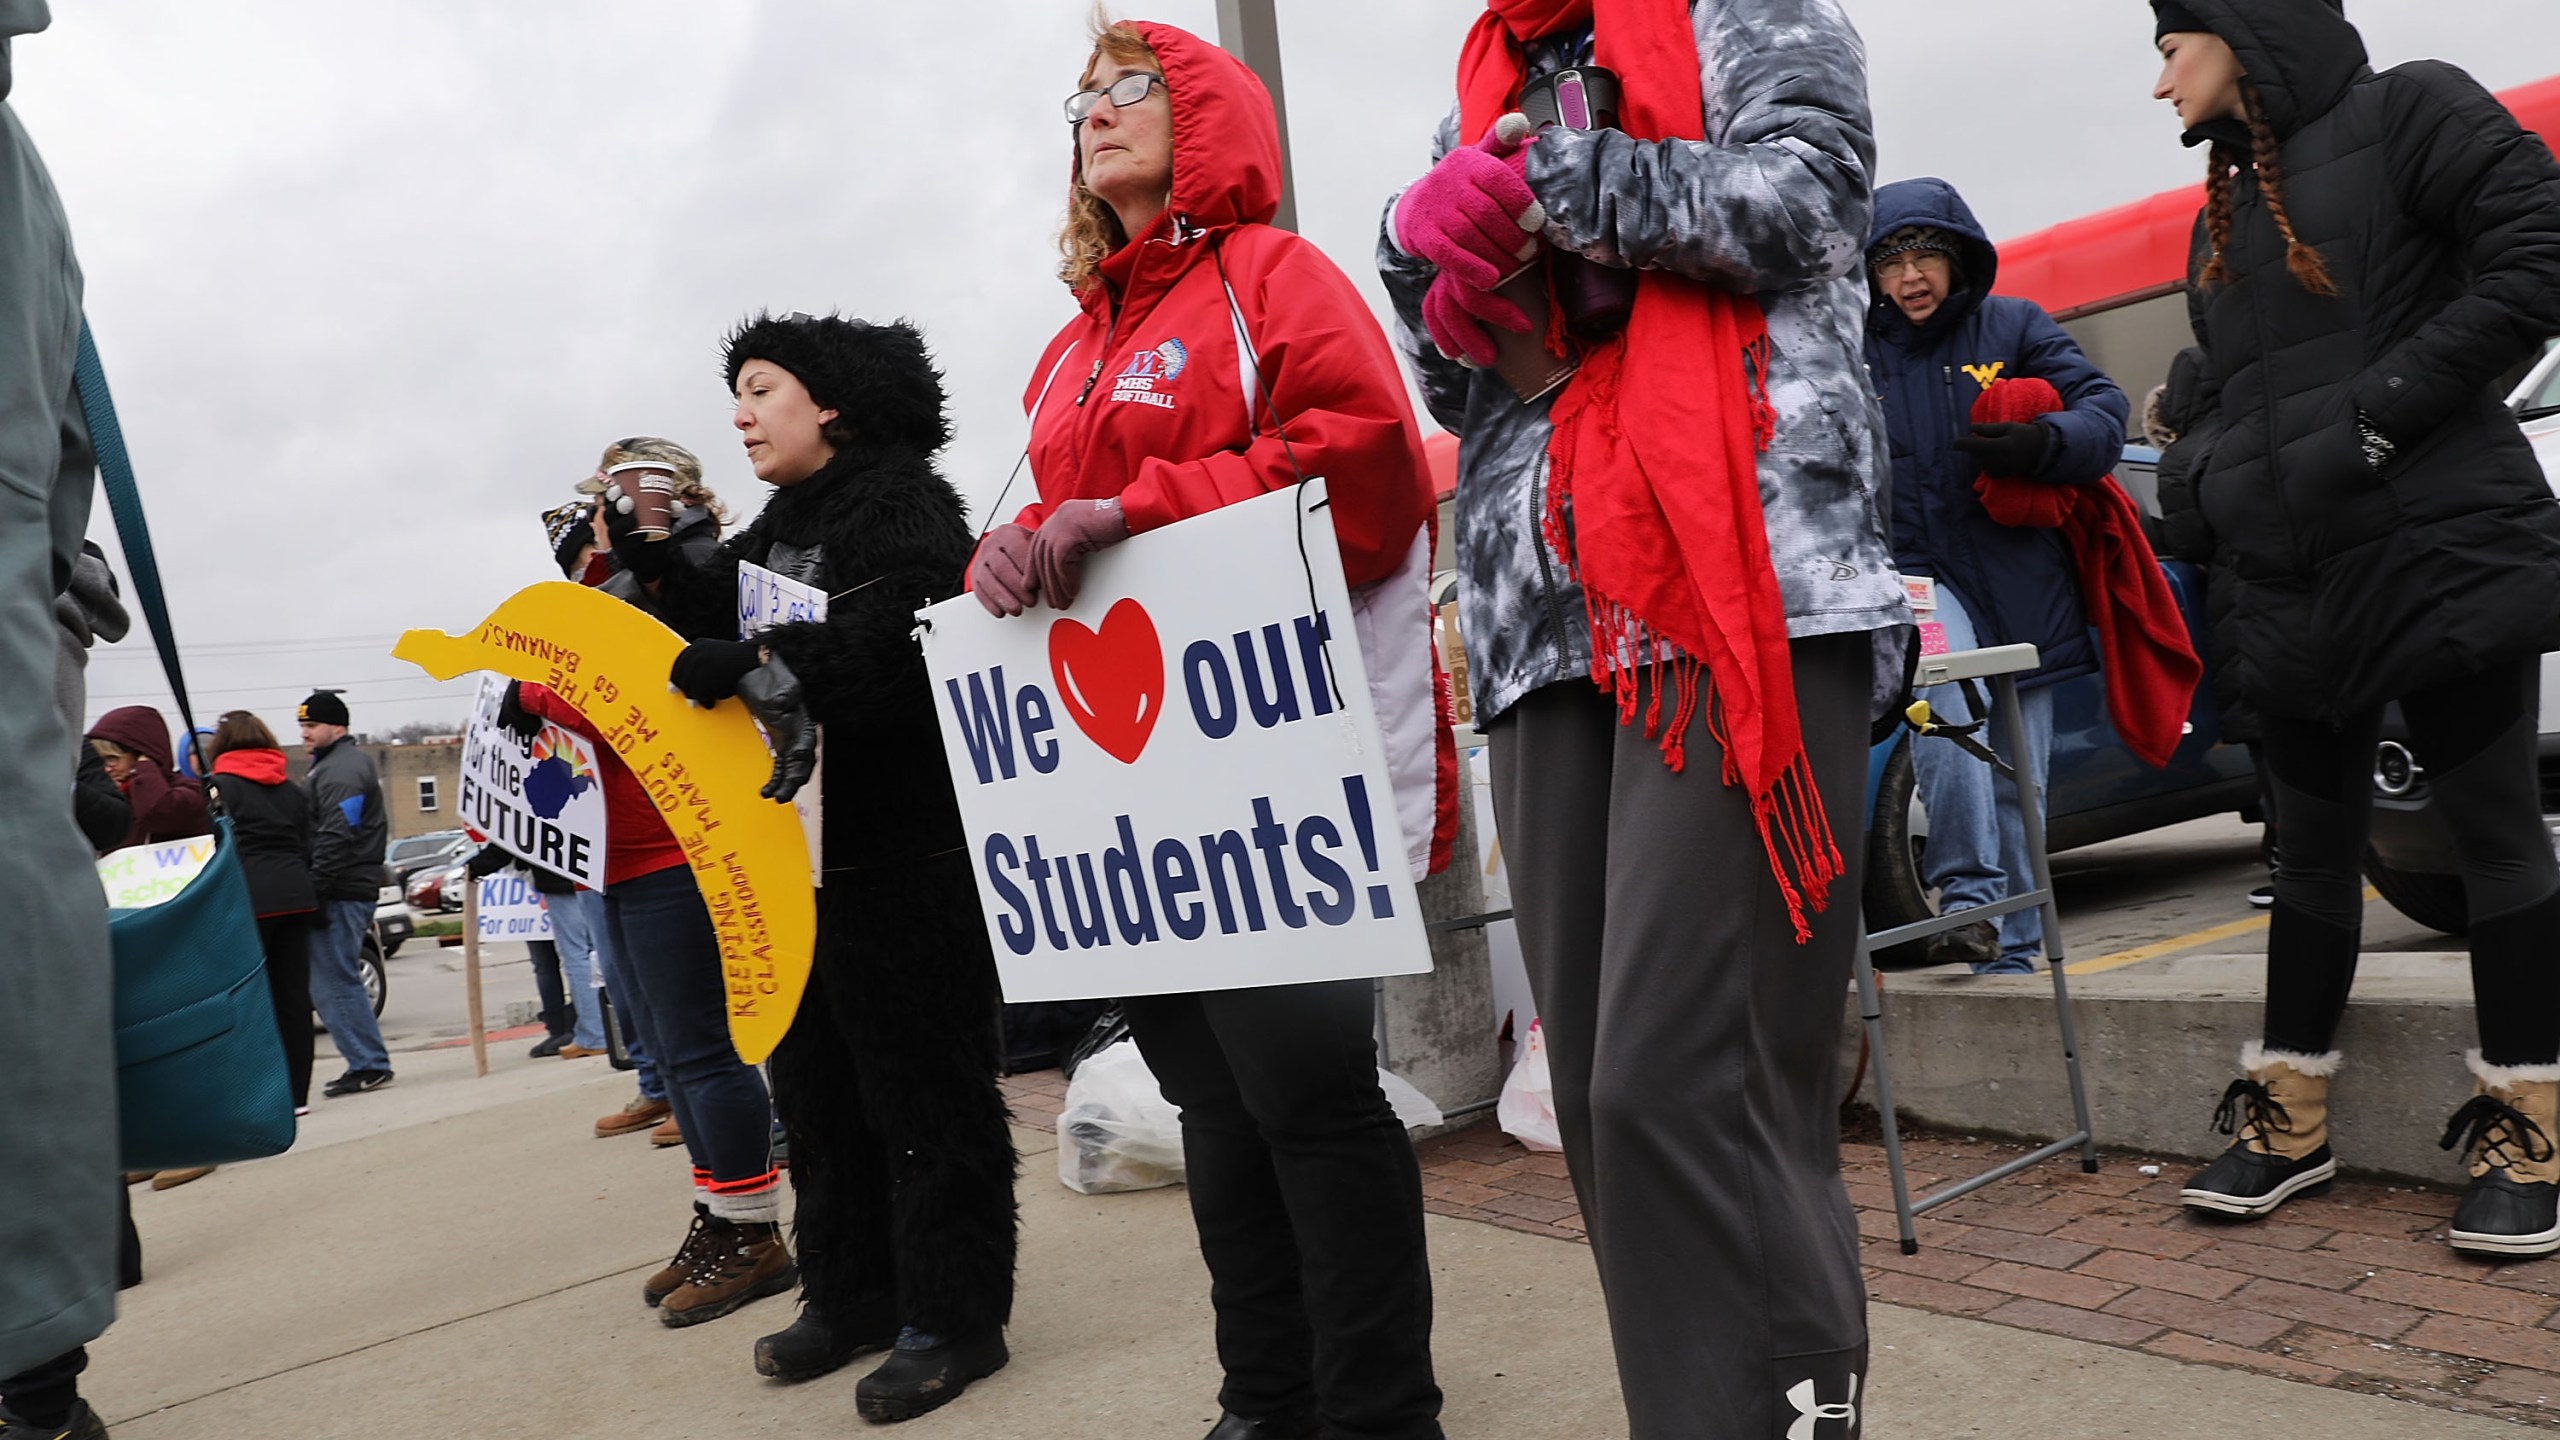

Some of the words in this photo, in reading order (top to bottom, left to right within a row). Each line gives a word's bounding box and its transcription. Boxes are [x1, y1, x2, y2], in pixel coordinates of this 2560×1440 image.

[1111, 389, 1176, 409] SOFTBALL
[1114, 377, 1154, 391] MHS
[480, 622, 581, 674] BANANAS!
[547, 667, 591, 714] THE
[593, 674, 621, 703] GO
[945, 664, 1060, 785] We
[1182, 609, 1334, 740] our
[604, 724, 636, 755] OF
[625, 704, 660, 743] ME
[490, 744, 520, 797] the
[636, 763, 680, 813] OUT
[660, 751, 722, 832] MAKES
[461, 773, 592, 880] FUTURE
[682, 831, 716, 871] ME
[984, 774, 1396, 956] Students!
[479, 915, 502, 934] For
[508, 918, 535, 934] our
[722, 851, 779, 994] CLASSROOM
[710, 890, 758, 1018] KEEPING
